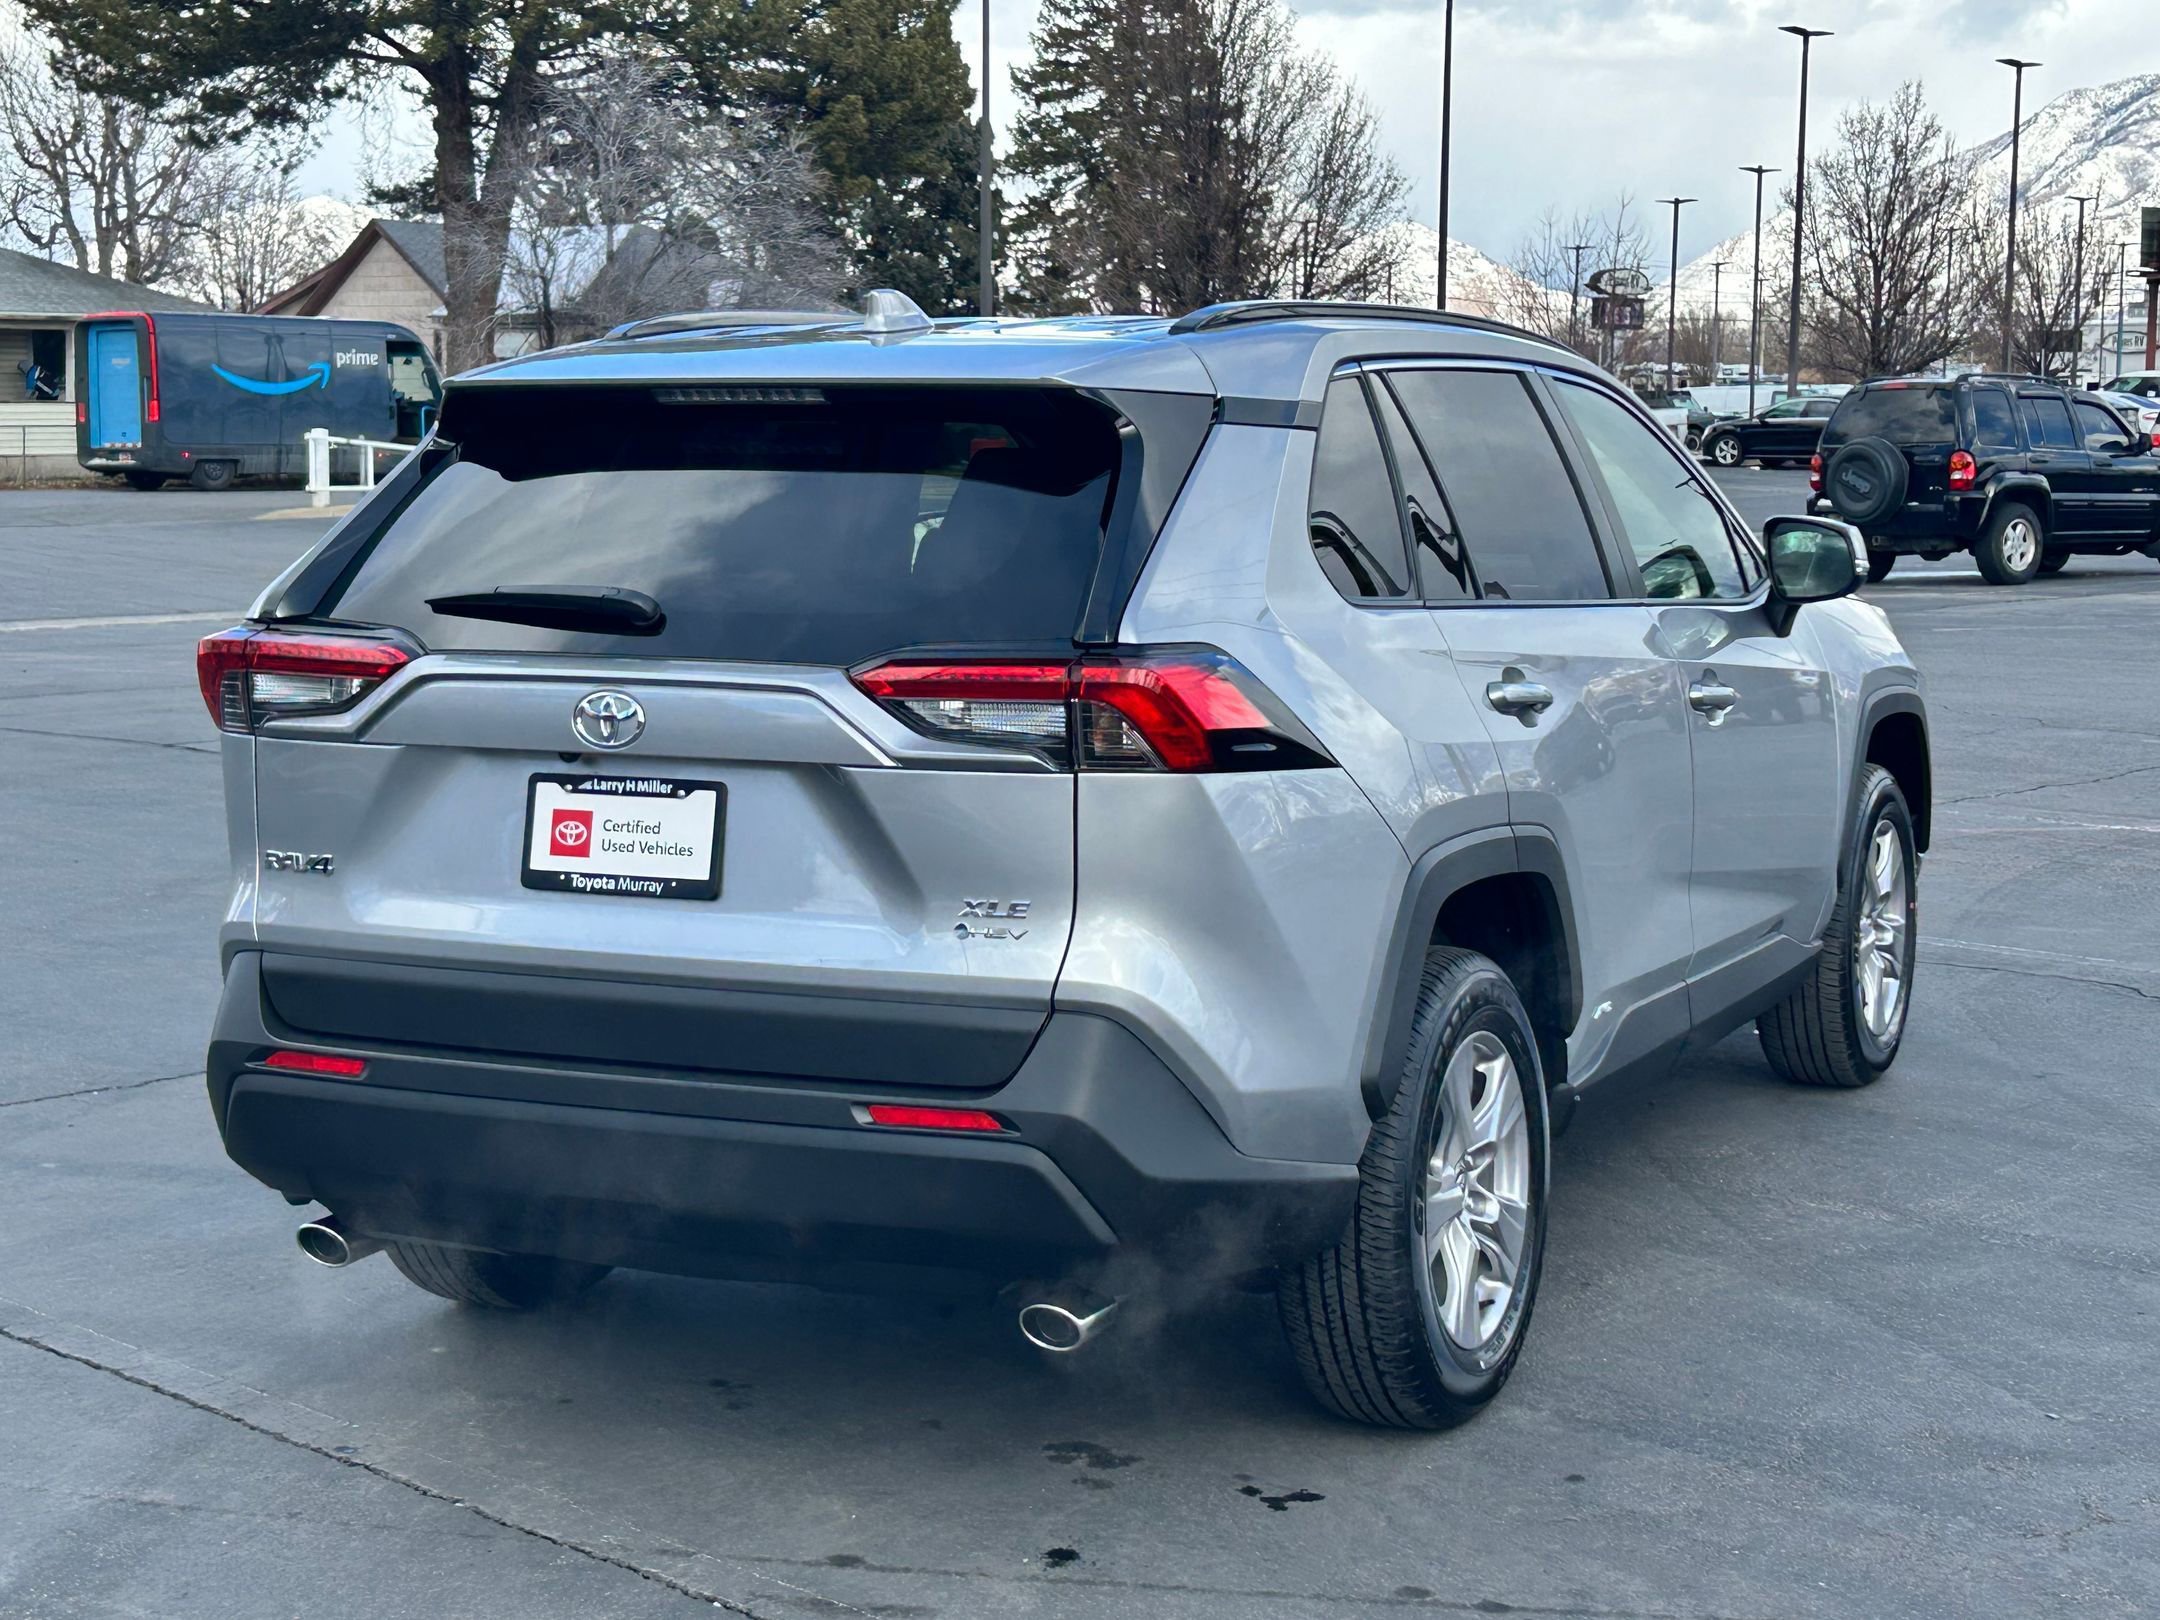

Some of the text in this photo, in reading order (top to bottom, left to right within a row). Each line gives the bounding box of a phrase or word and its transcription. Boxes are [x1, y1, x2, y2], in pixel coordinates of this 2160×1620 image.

[2134, 335, 2145, 347] RV
[336, 348, 379, 368] prime
[1842, 469, 1871, 493] Jeep
[594, 778, 673, 794] Larry H Miller
[603, 819, 661, 835] Certified
[602, 839, 694, 857] Used Vehicles
[265, 849, 335, 876] RAV4
[571, 874, 664, 896] Toyota Murray
[957, 898, 1031, 919] XLE
